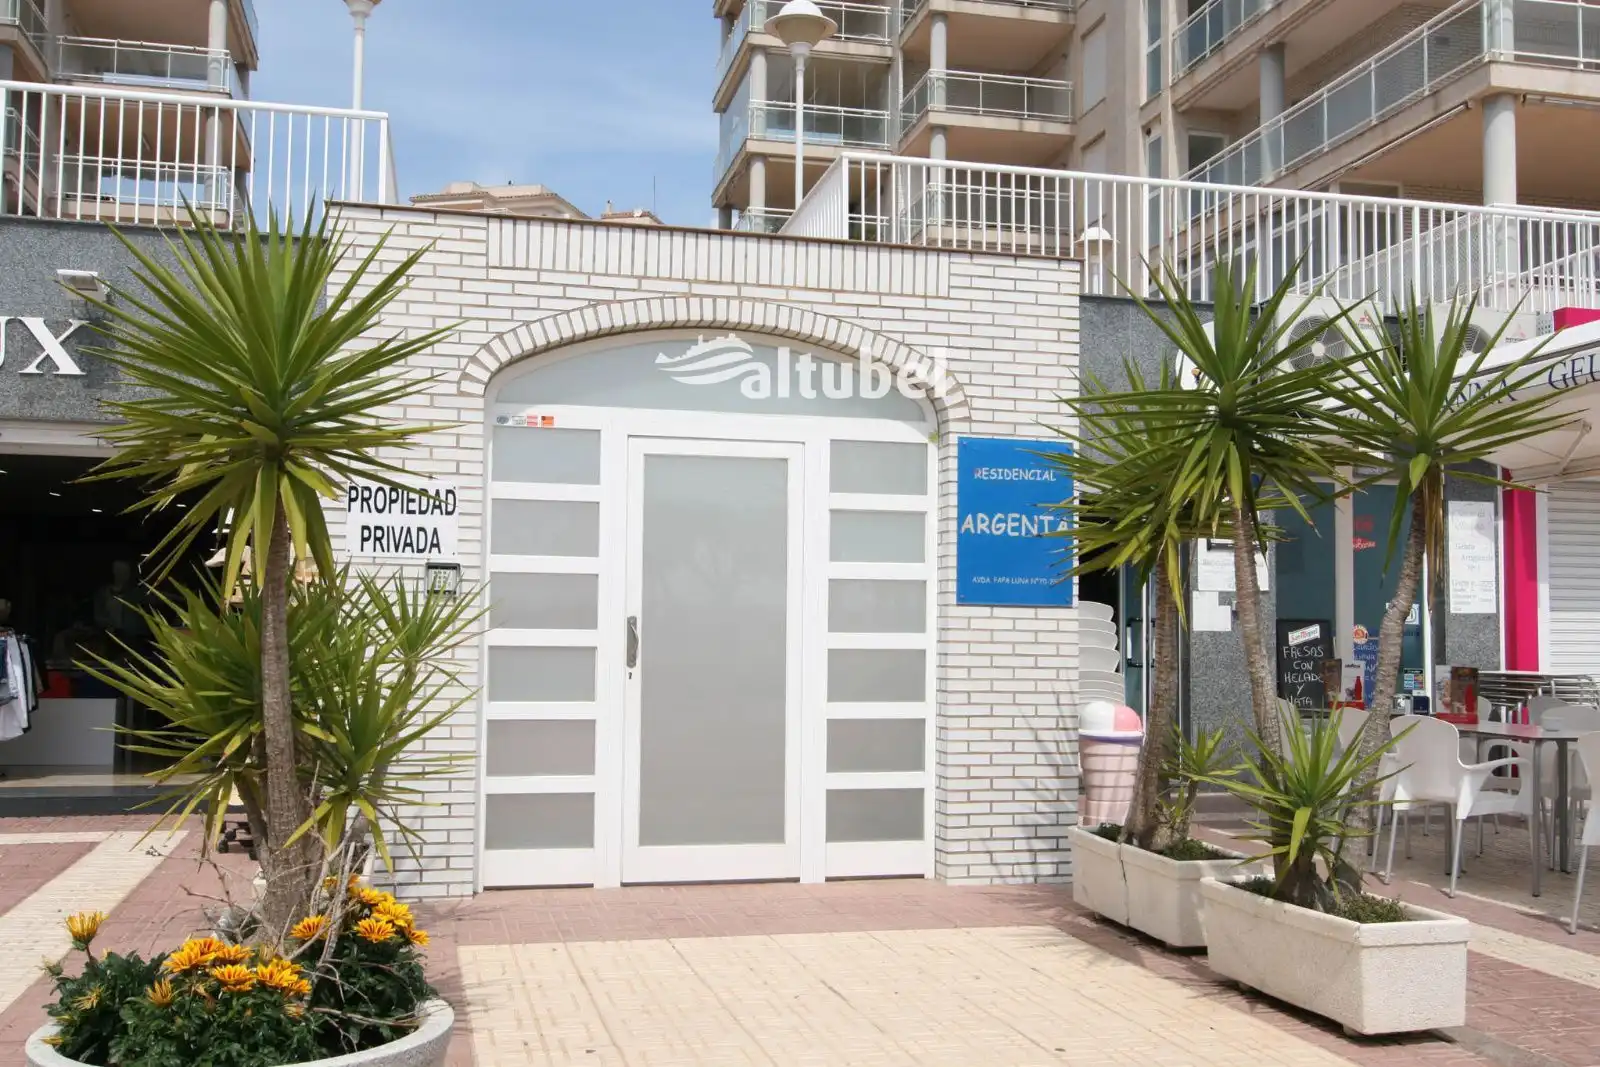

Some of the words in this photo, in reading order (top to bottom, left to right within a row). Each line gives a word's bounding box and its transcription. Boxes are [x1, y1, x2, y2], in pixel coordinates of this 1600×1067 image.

[0, 315, 90, 375] X
[973, 467, 1057, 482] RESIDENCIAL
[347, 485, 457, 516] PROPIEDAD
[960, 512, 1069, 537] ARGENTA
[360, 525, 442, 554] PRIVADA
[1011, 576, 1030, 585] LUNA
[1293, 660, 1314, 670] CON
